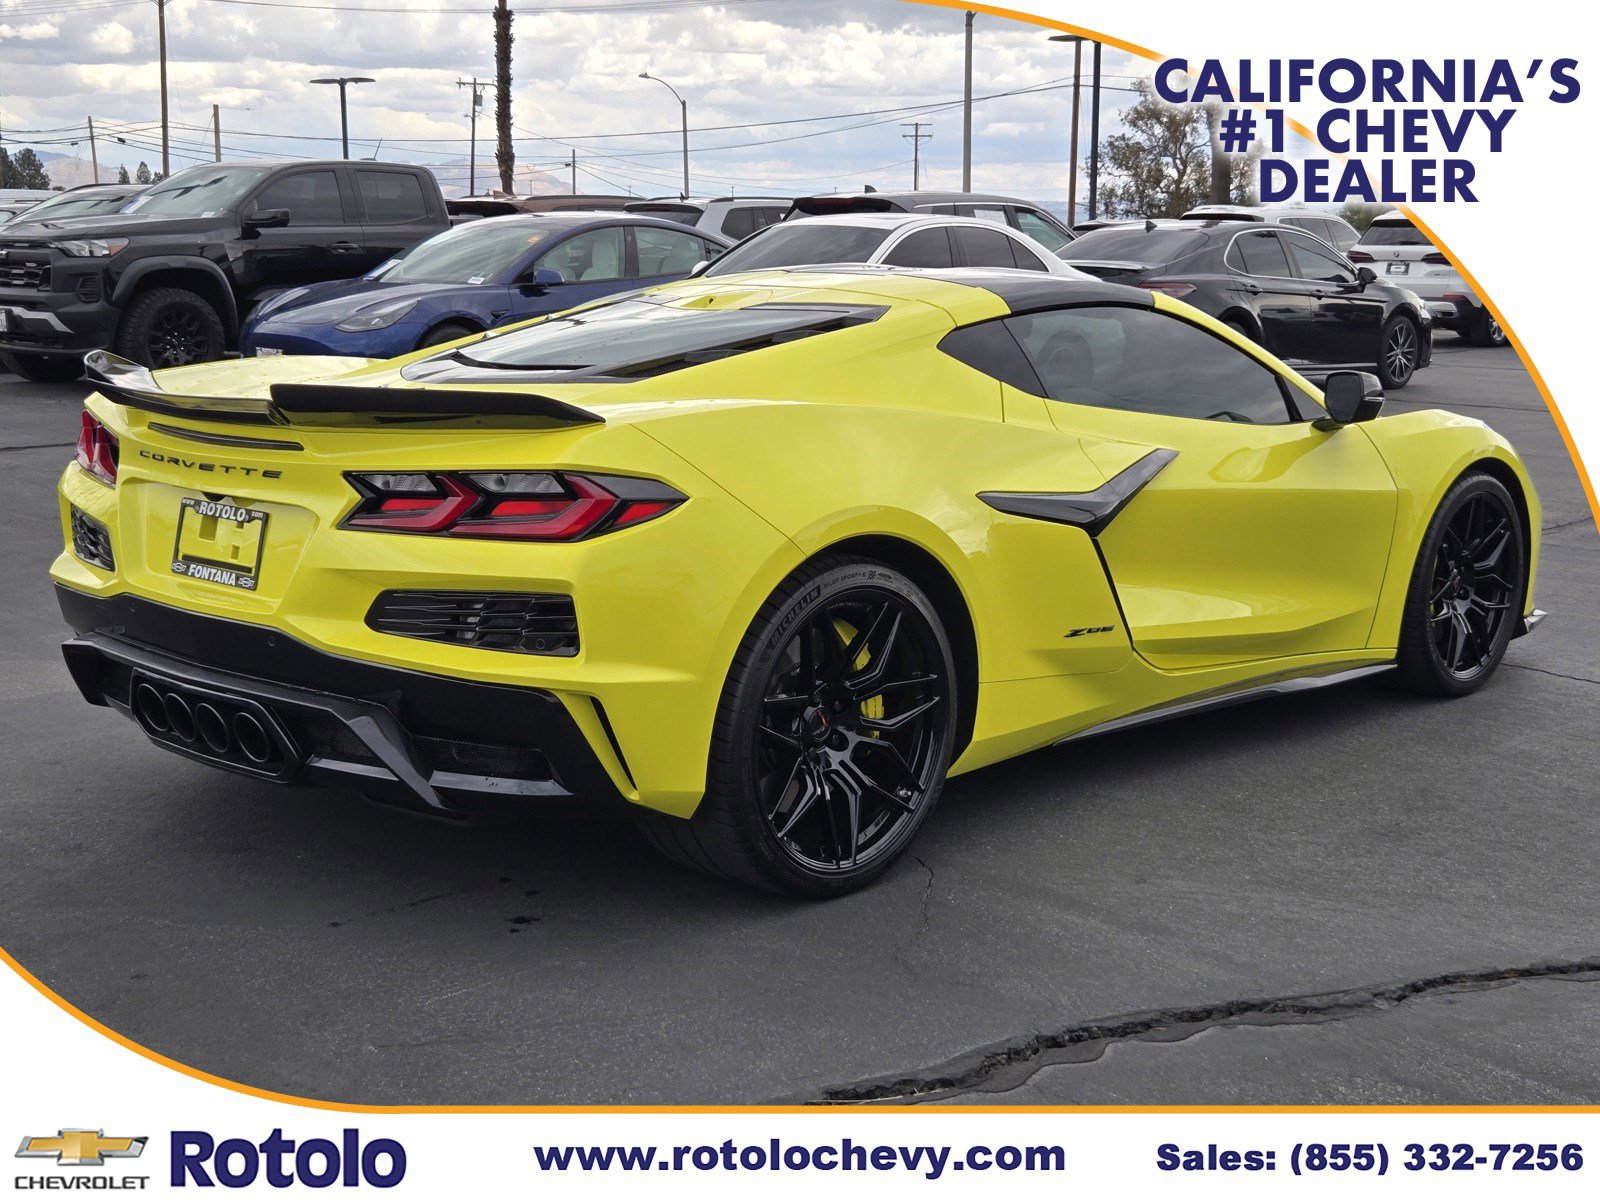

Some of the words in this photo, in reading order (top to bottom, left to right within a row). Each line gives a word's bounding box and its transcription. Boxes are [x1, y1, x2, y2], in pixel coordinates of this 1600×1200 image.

[139, 450, 283, 479] CORVETTE
[199, 501, 246, 522] ROTOLO
[188, 564, 236, 586] FONTANA
[840, 572, 858, 582] SPORT
[771, 588, 819, 646] MICHELIN
